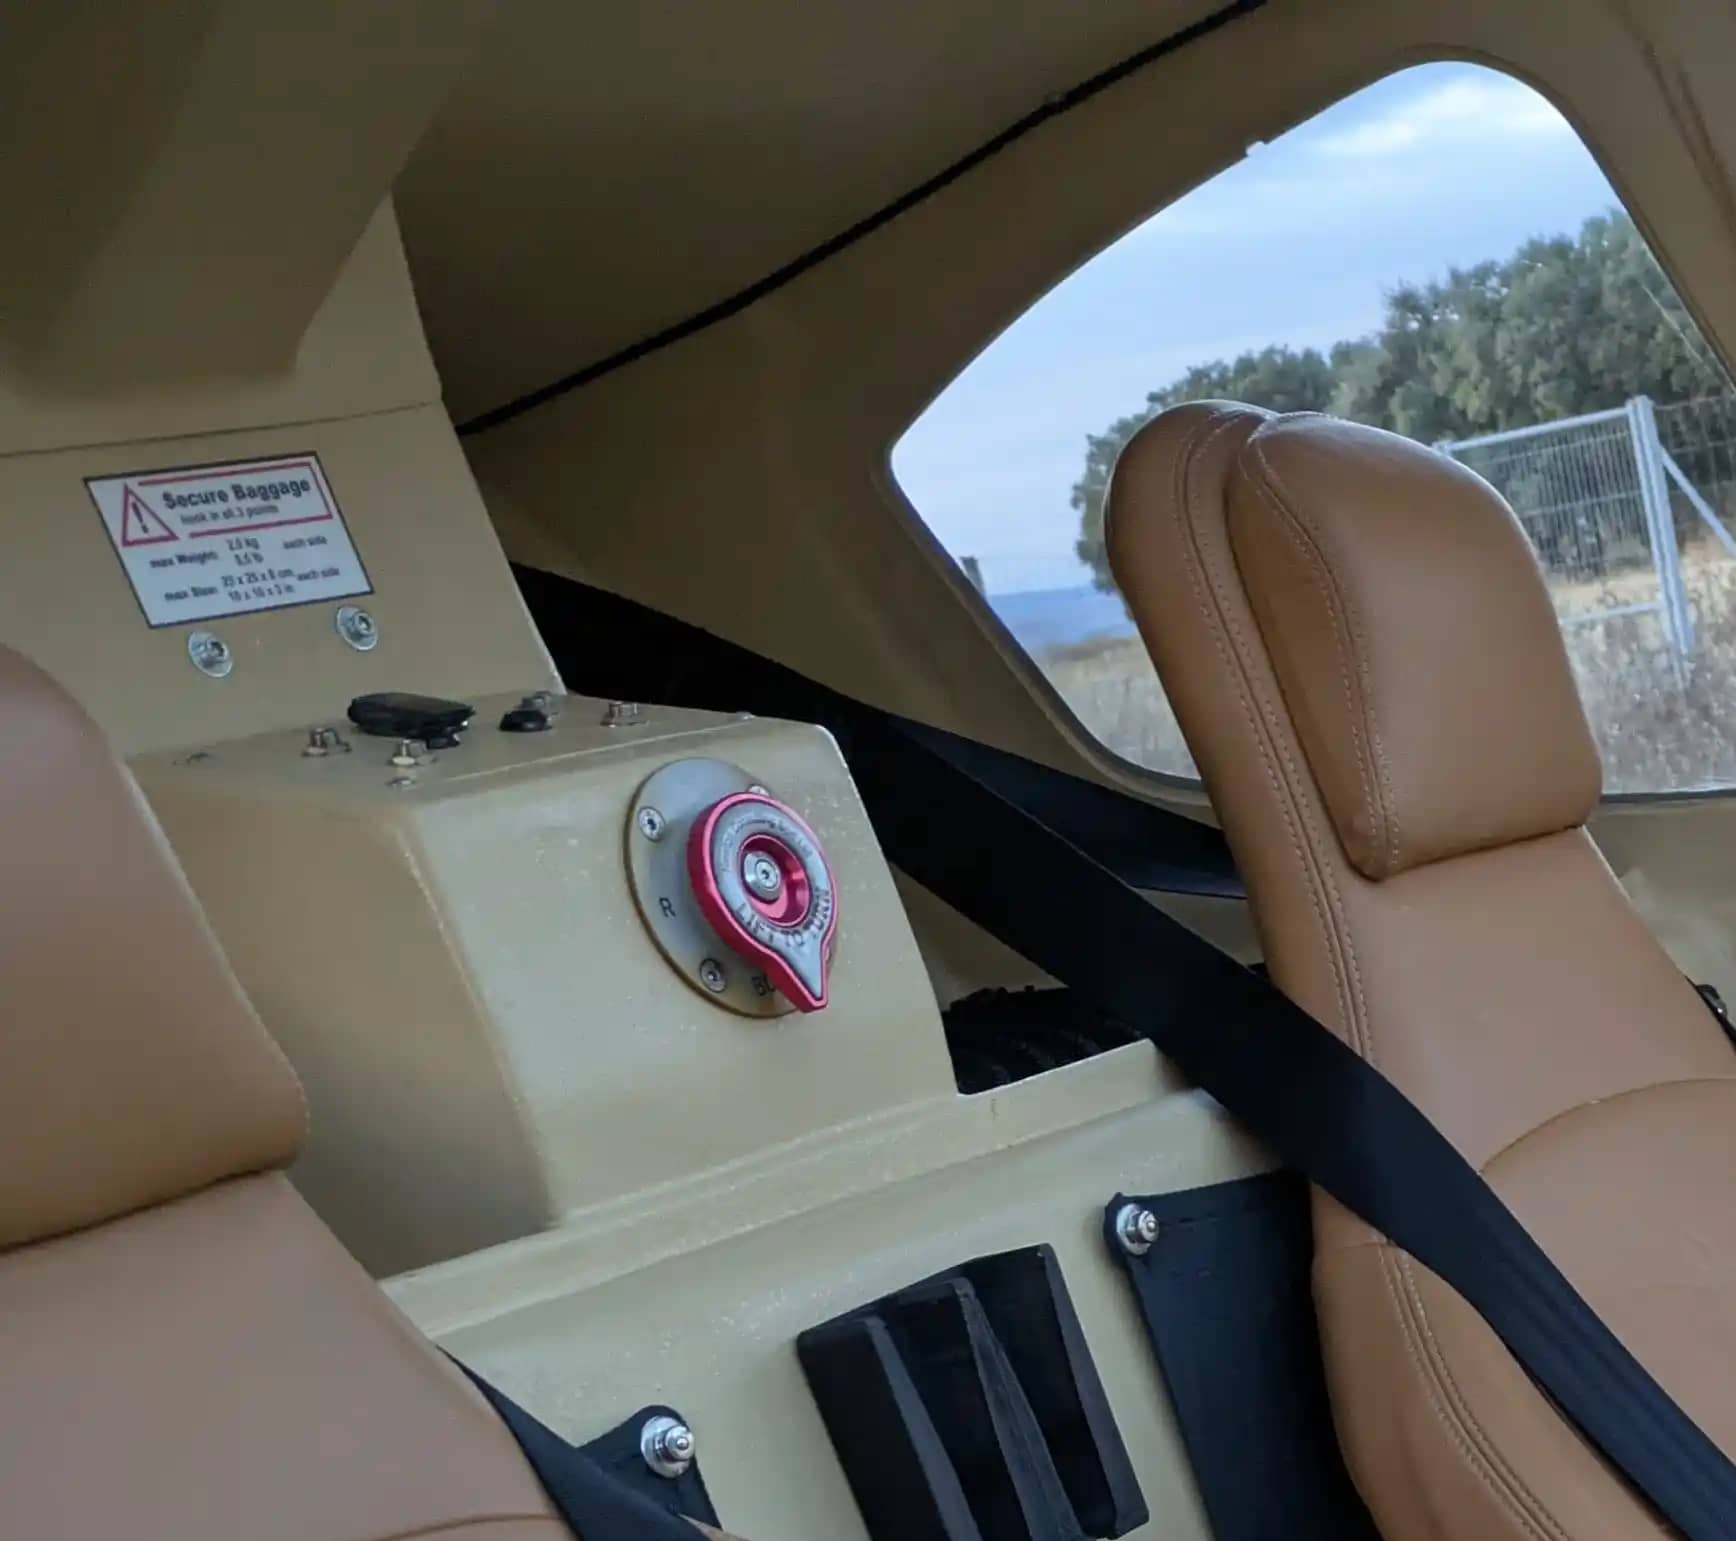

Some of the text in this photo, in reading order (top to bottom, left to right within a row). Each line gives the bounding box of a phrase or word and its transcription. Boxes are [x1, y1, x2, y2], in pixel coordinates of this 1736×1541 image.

[162, 479, 311, 510] Secure Baggage
[658, 896, 677, 918] R
